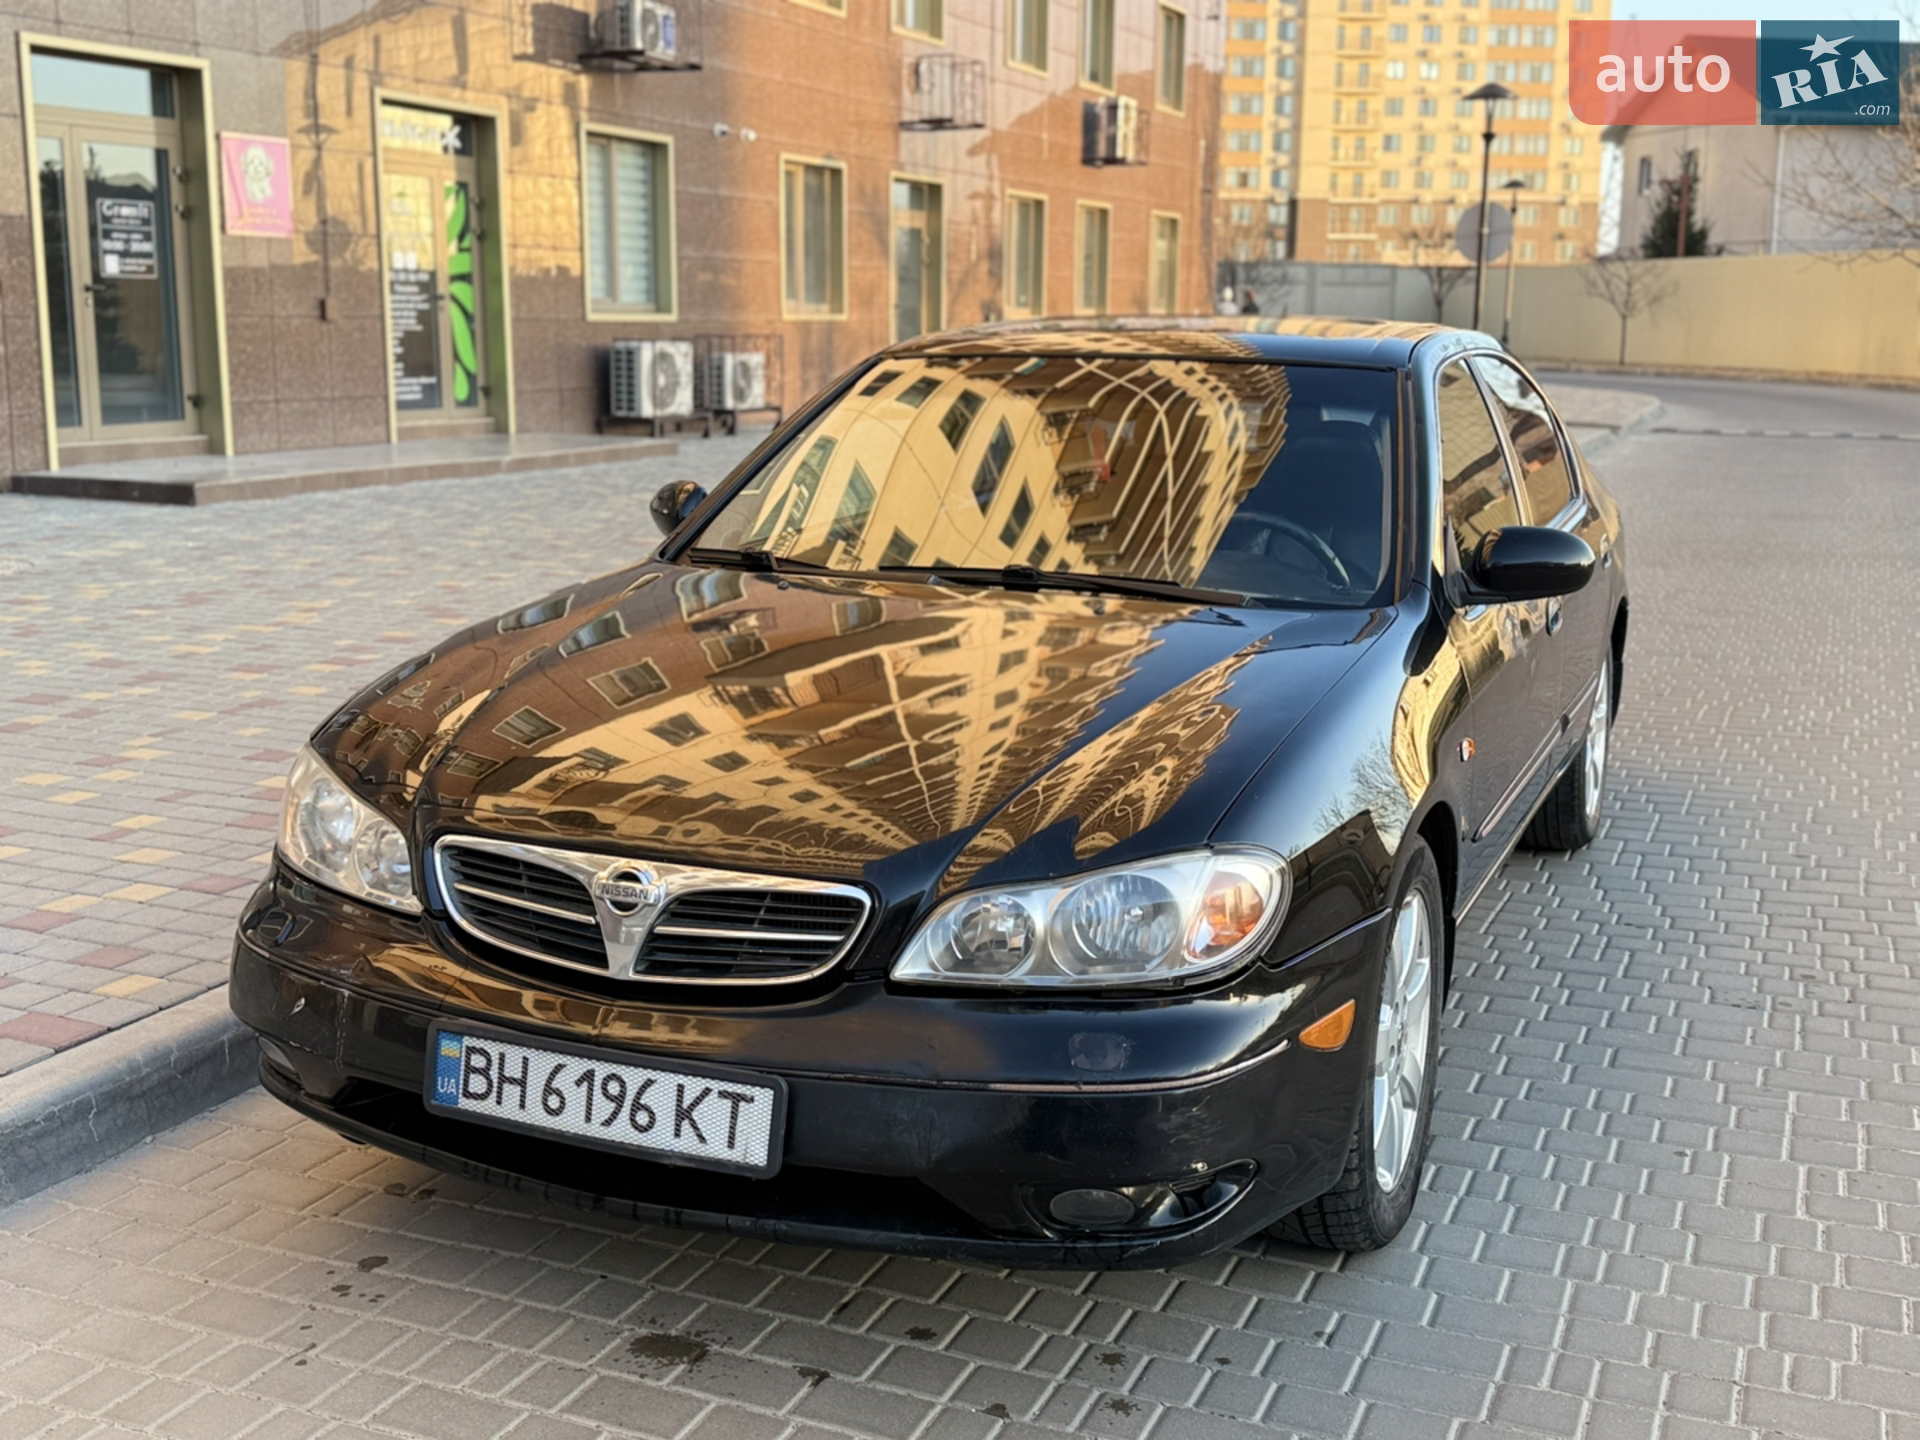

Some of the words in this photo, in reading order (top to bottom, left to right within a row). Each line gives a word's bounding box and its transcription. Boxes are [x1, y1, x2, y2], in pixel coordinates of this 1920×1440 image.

[601, 884, 649, 900] NISSAN
[437, 1074, 458, 1096] UA
[462, 1045, 529, 1110] BH
[541, 1063, 656, 1133] 6196
[673, 1083, 755, 1149] KT
